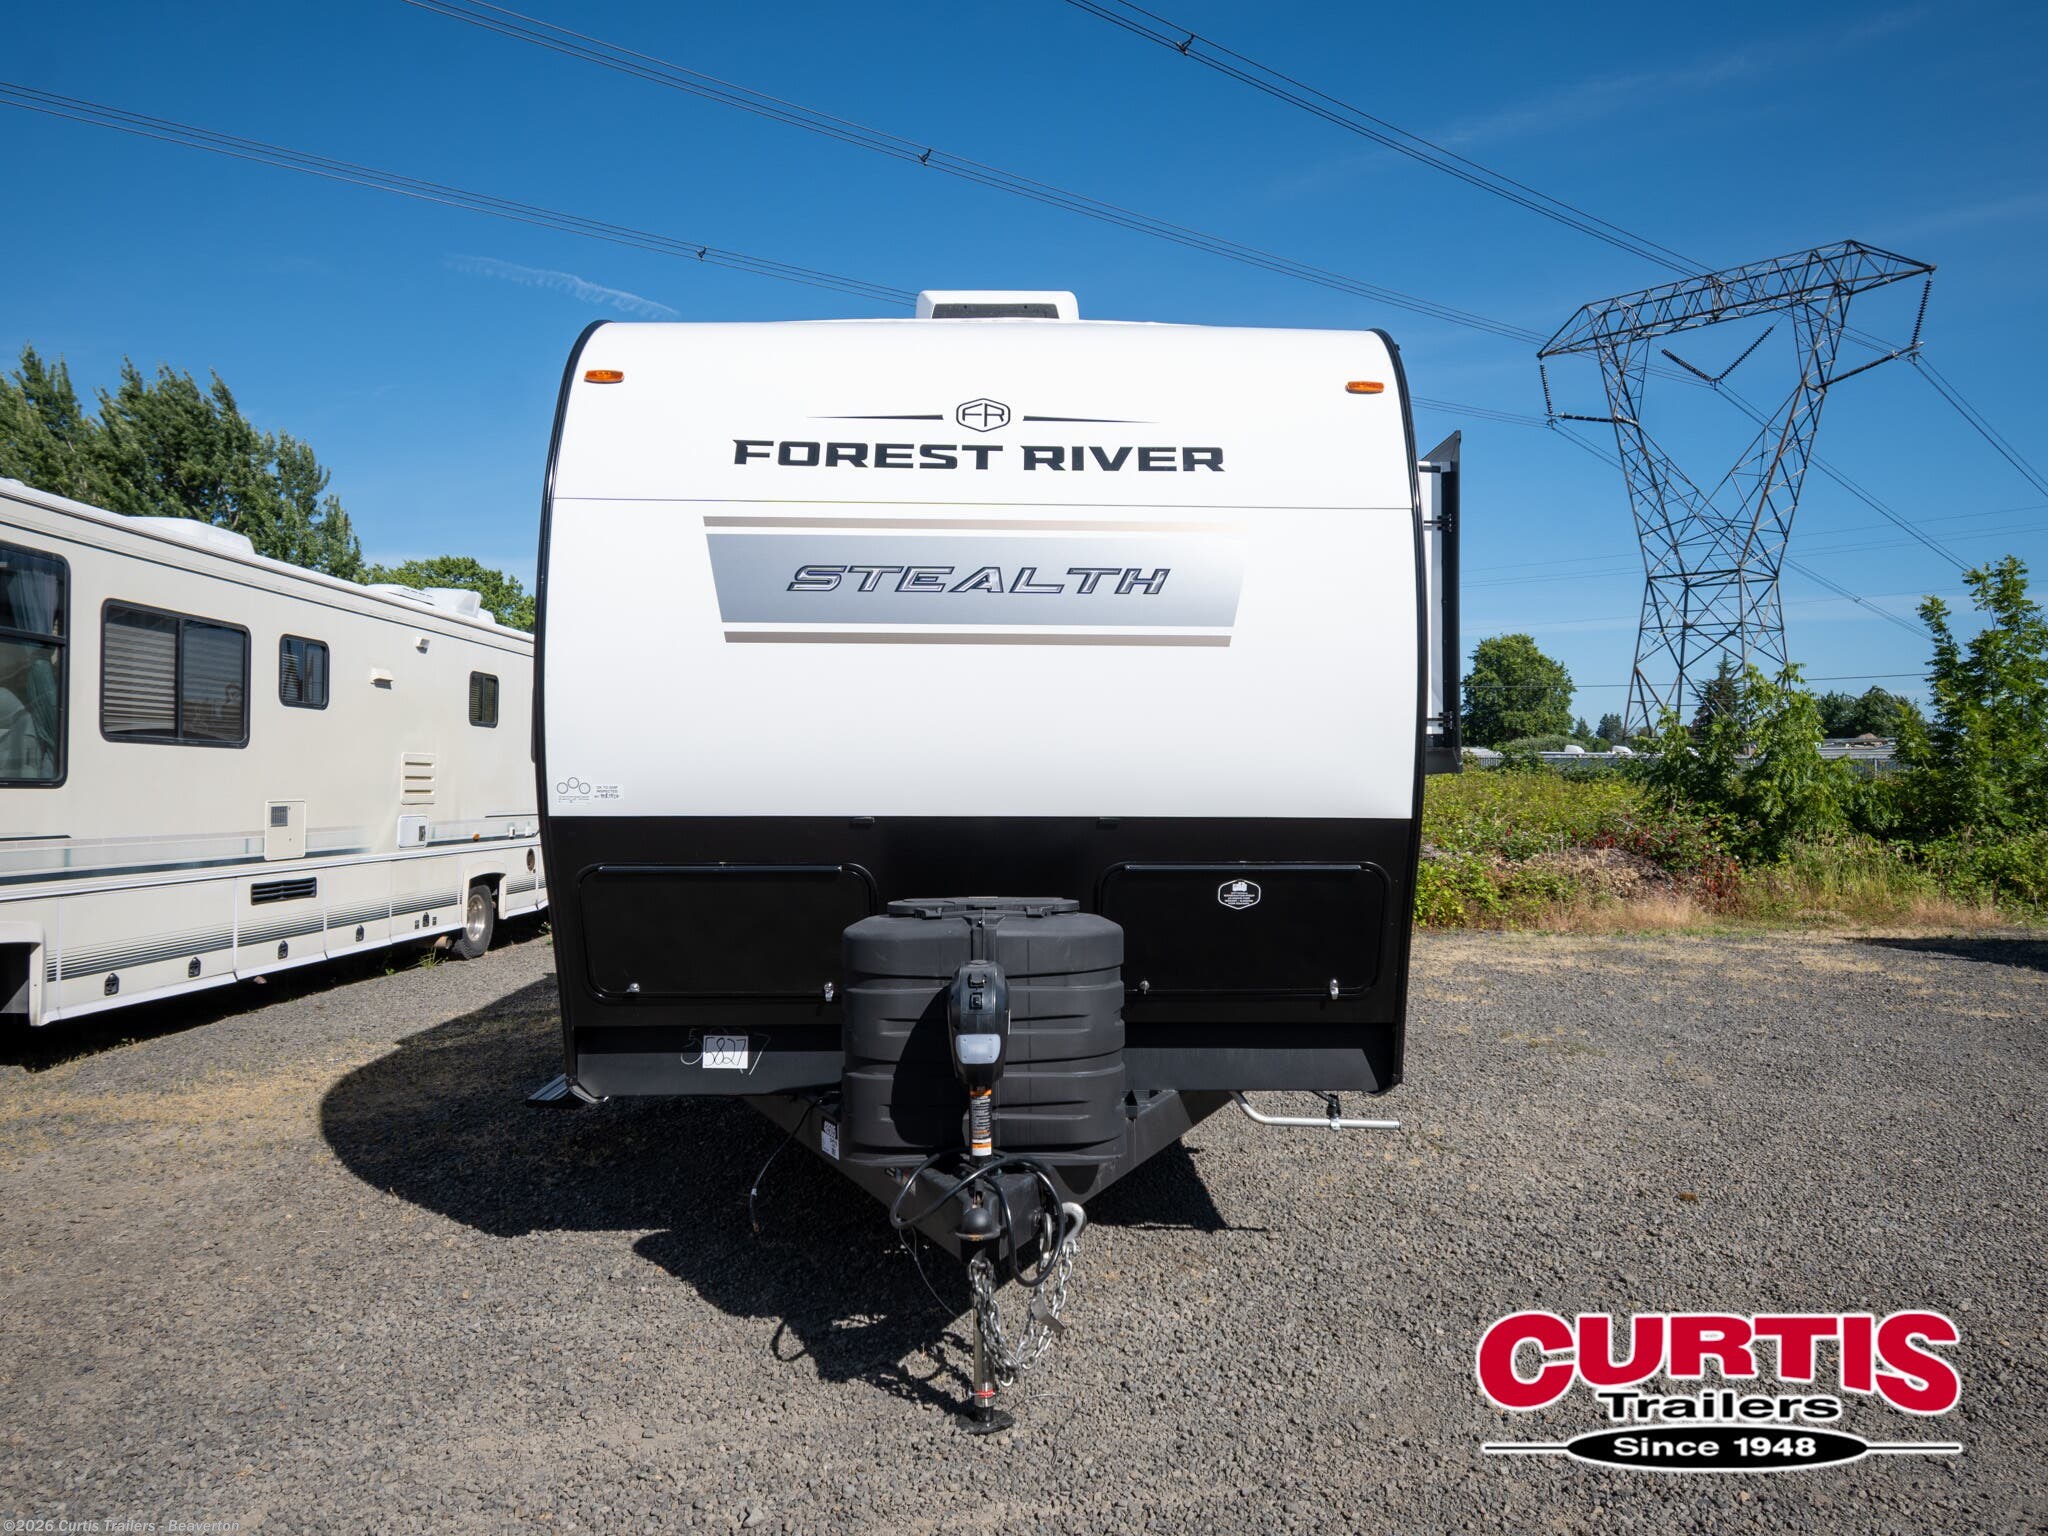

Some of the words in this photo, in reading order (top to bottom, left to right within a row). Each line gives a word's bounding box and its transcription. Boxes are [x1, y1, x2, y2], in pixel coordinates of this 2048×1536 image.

[733, 439, 1004, 470] FOREST
[1020, 445, 1226, 473] RIVER
[786, 564, 1171, 595] STEALTH
